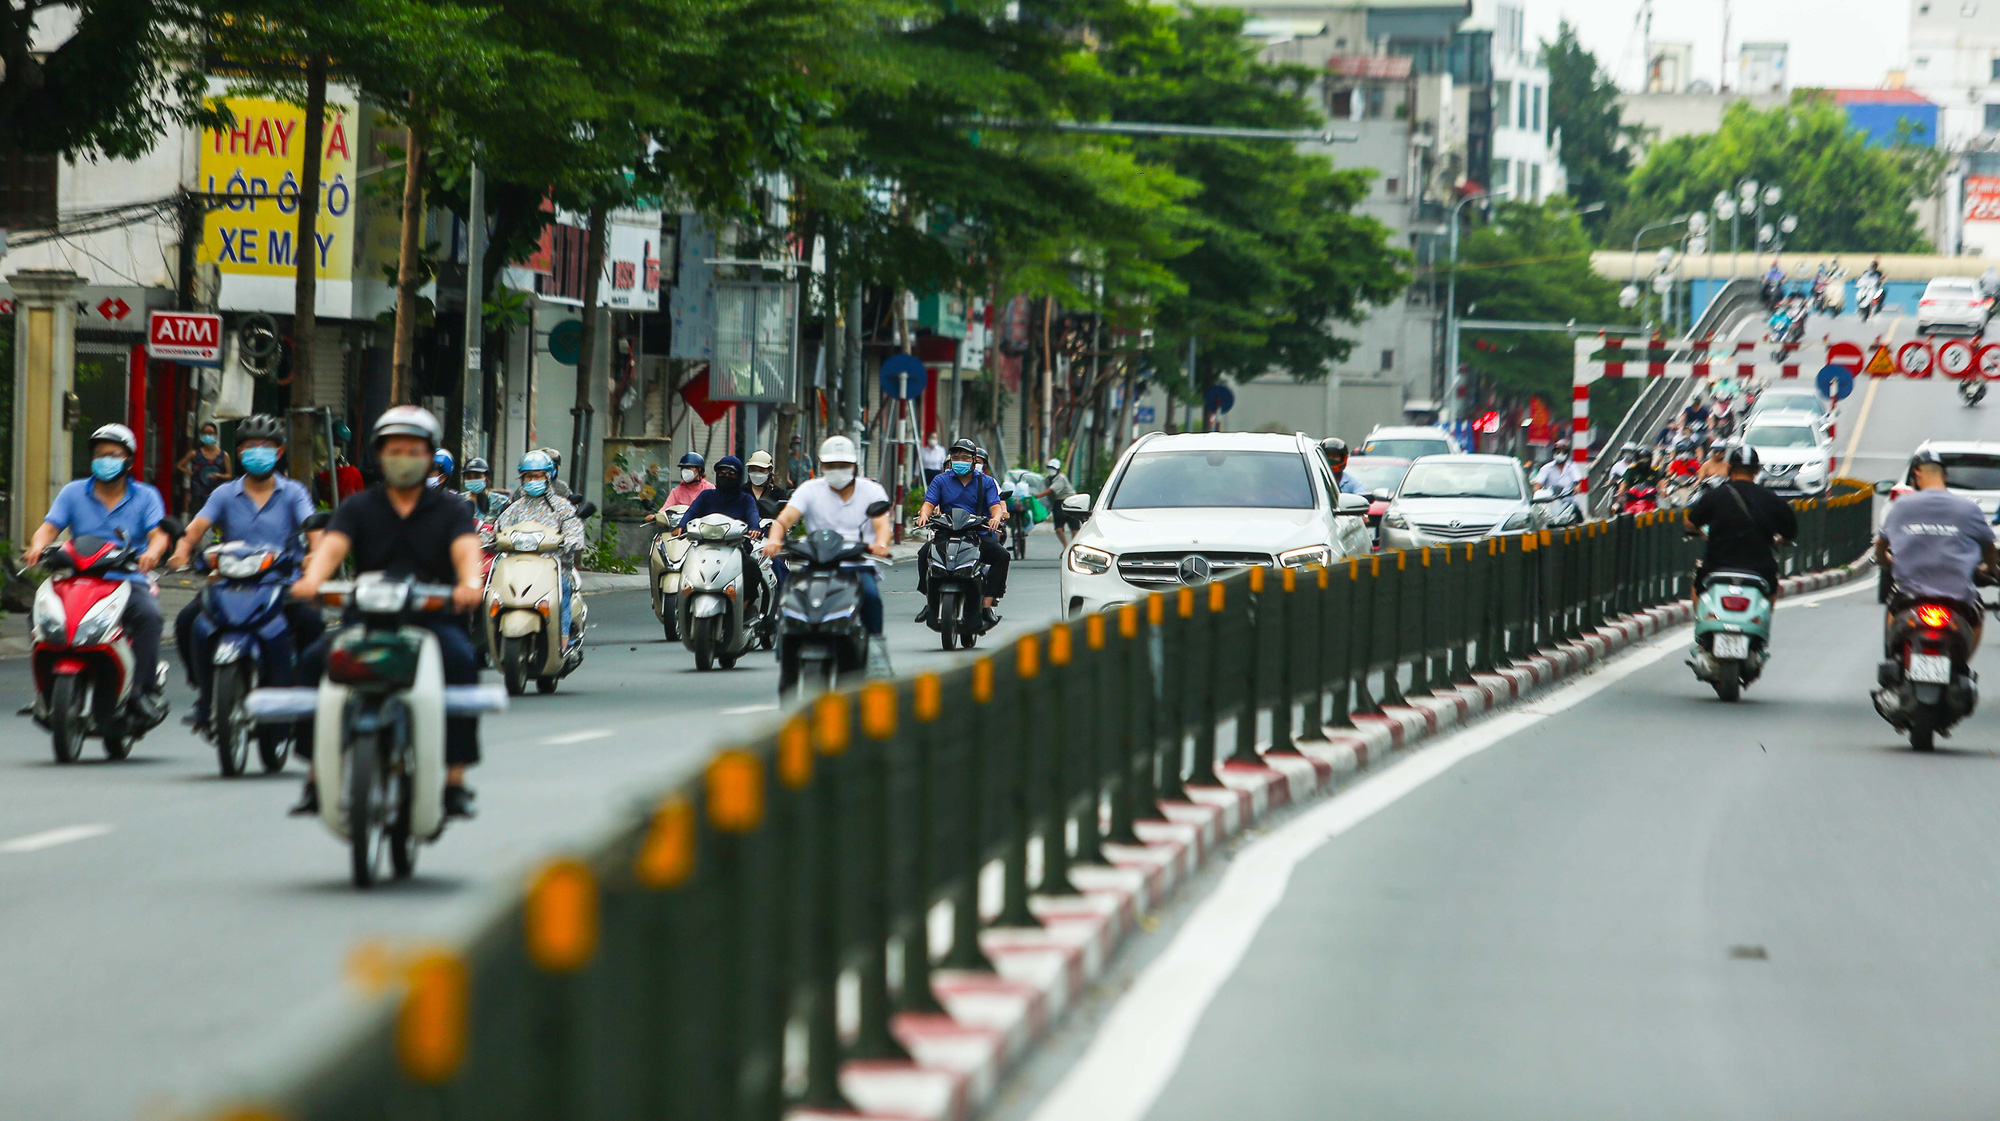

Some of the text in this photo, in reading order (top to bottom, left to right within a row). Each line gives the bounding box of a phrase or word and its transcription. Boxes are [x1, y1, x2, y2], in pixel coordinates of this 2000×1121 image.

[304, 111, 350, 161] Á
[218, 226, 334, 268] XE MY
[157, 317, 213, 342] ATM
